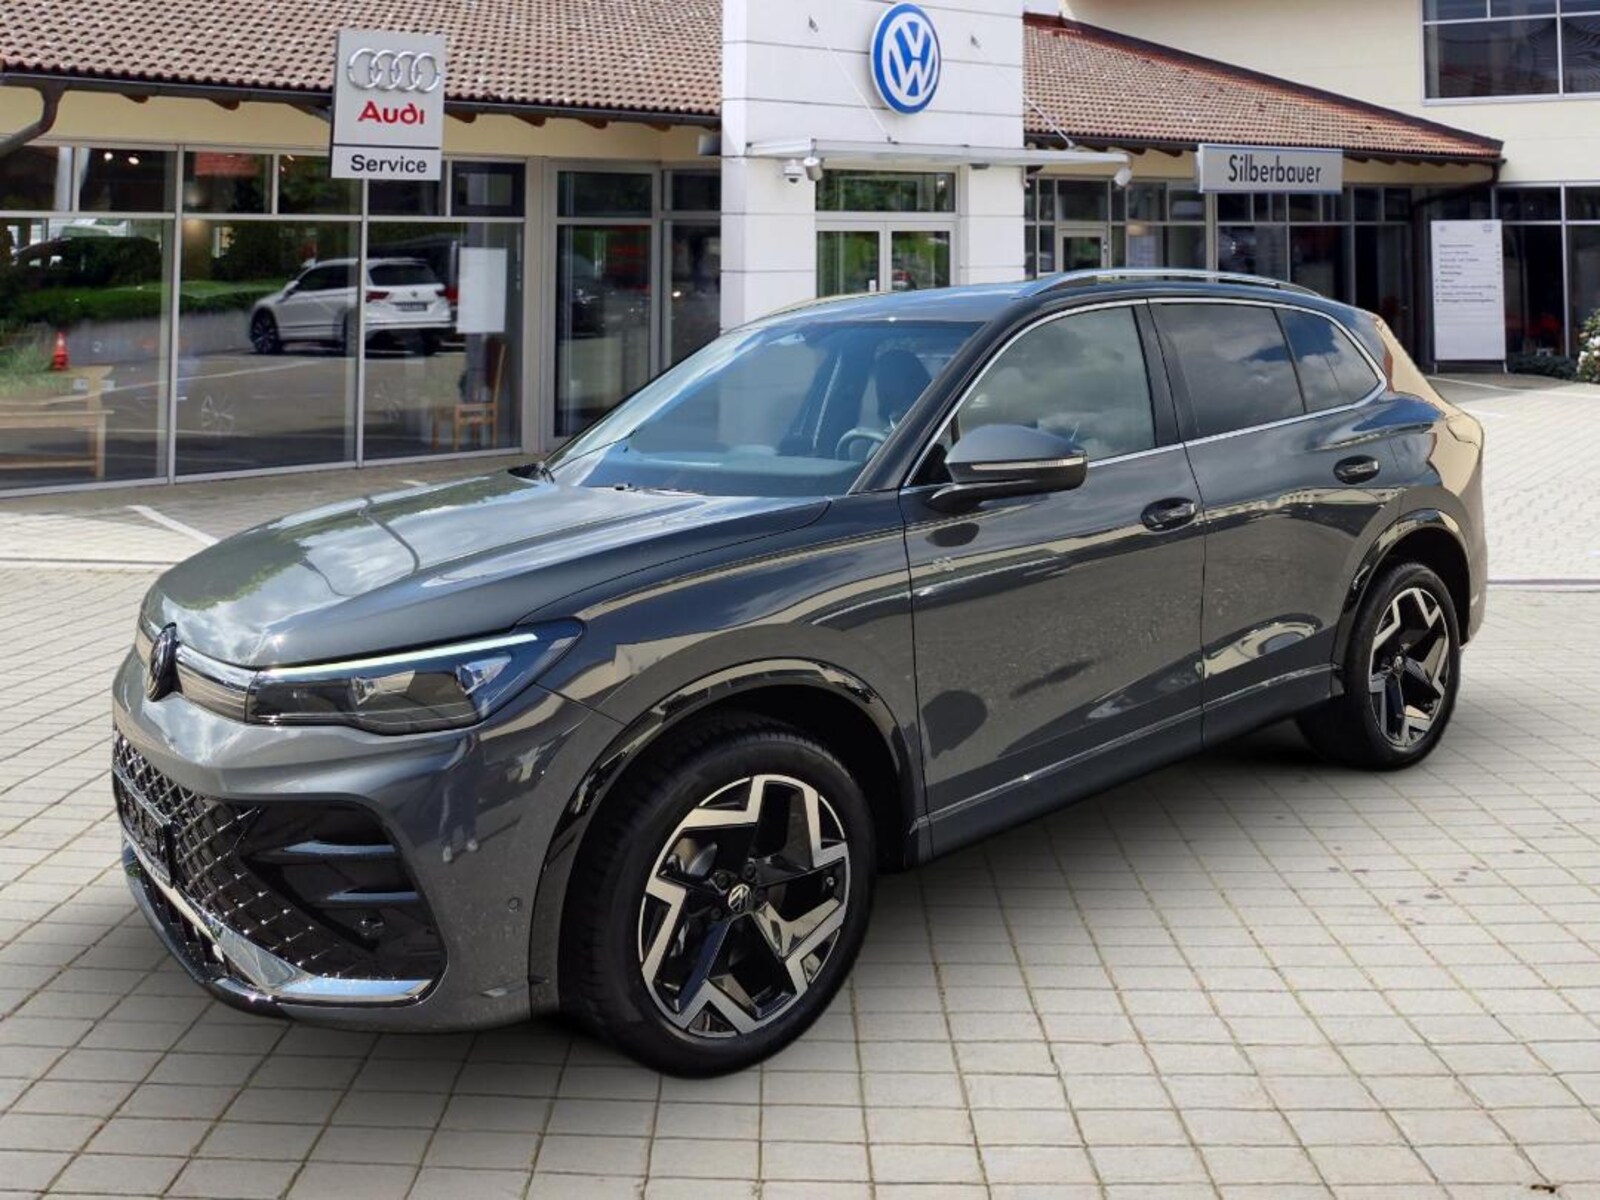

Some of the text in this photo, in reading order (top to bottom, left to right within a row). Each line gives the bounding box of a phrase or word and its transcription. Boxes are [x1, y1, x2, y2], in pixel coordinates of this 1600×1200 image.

[357, 100, 425, 125] Audi
[350, 154, 427, 173] Service
[1228, 153, 1321, 183] Silberbauer
